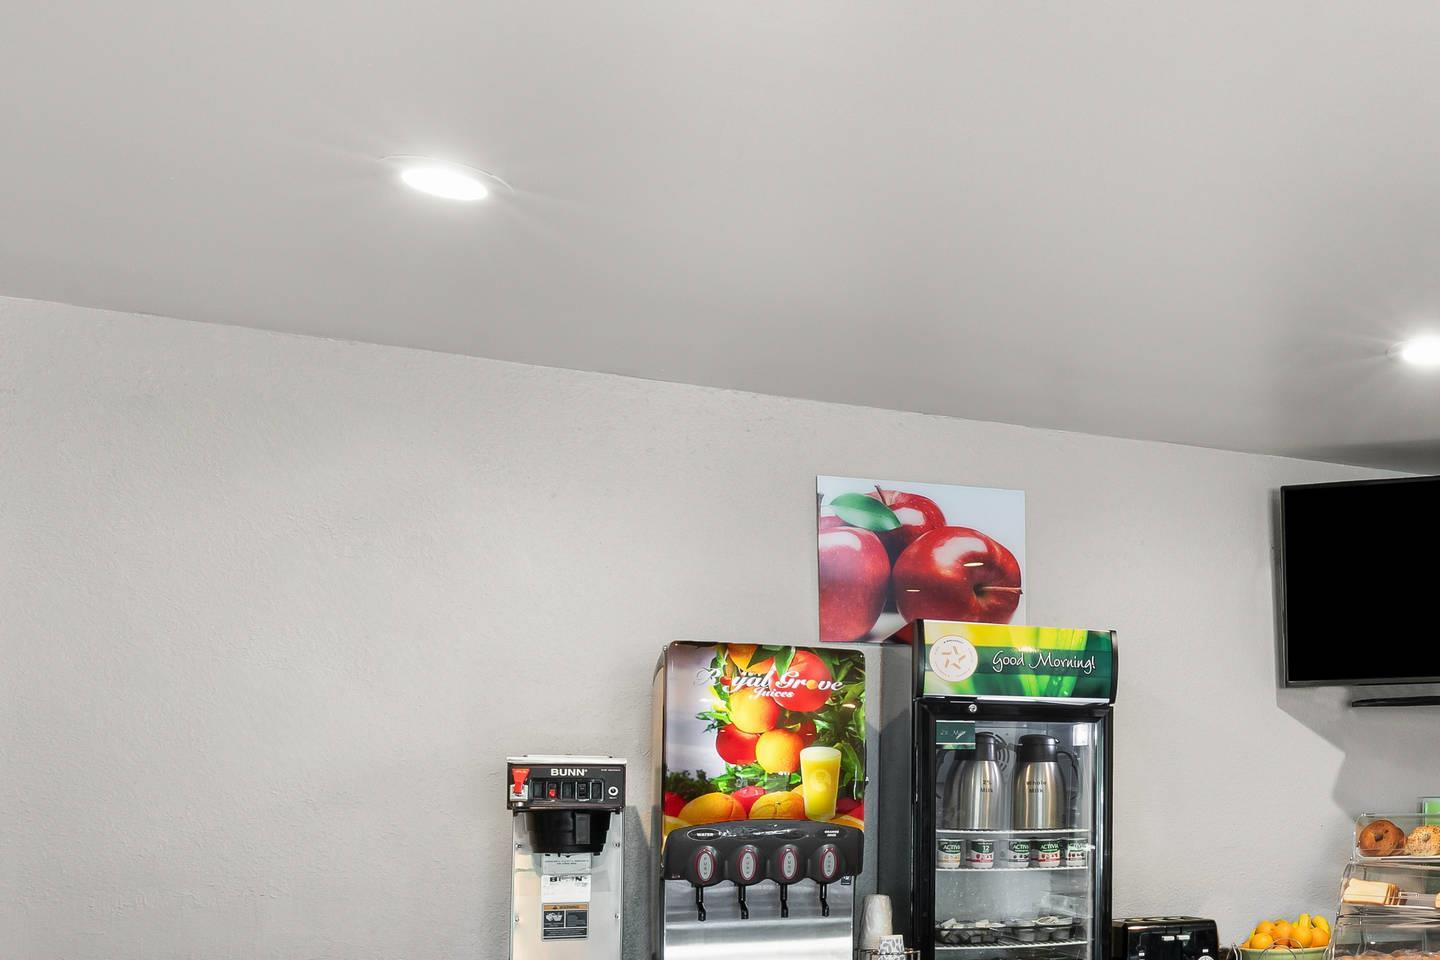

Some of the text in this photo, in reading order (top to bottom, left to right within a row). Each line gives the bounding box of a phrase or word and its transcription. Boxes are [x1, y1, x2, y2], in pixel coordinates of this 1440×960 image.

[992, 650, 1096, 675] Good Morning!
[775, 670, 845, 691] Grove
[752, 687, 795, 698] Juices
[550, 768, 586, 776] BUNN
